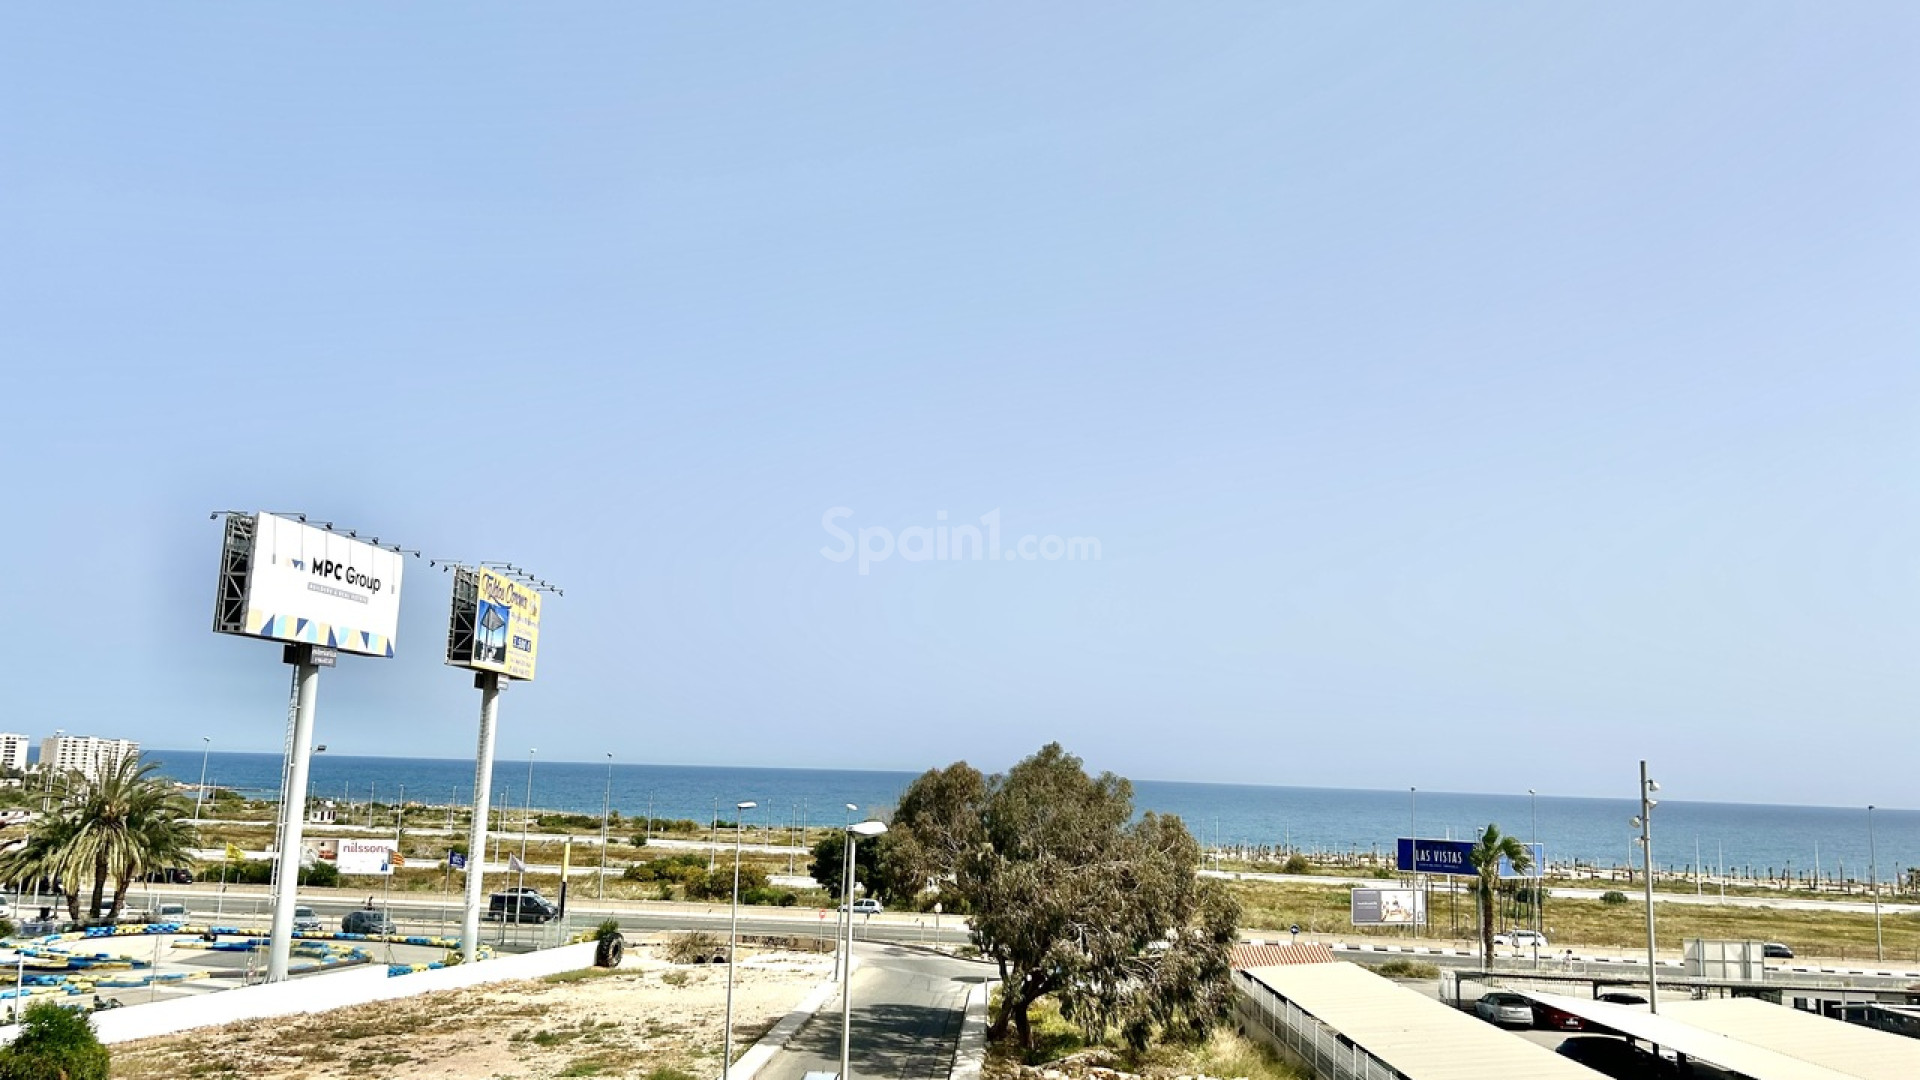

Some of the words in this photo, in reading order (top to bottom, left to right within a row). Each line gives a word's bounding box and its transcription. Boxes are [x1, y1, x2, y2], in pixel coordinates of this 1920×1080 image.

[311, 557, 343, 581] MPC
[346, 566, 381, 595] Group
[343, 842, 391, 853] nilssons
[1415, 849, 1431, 861] LAS
[1433, 850, 1462, 864] VISTAS
